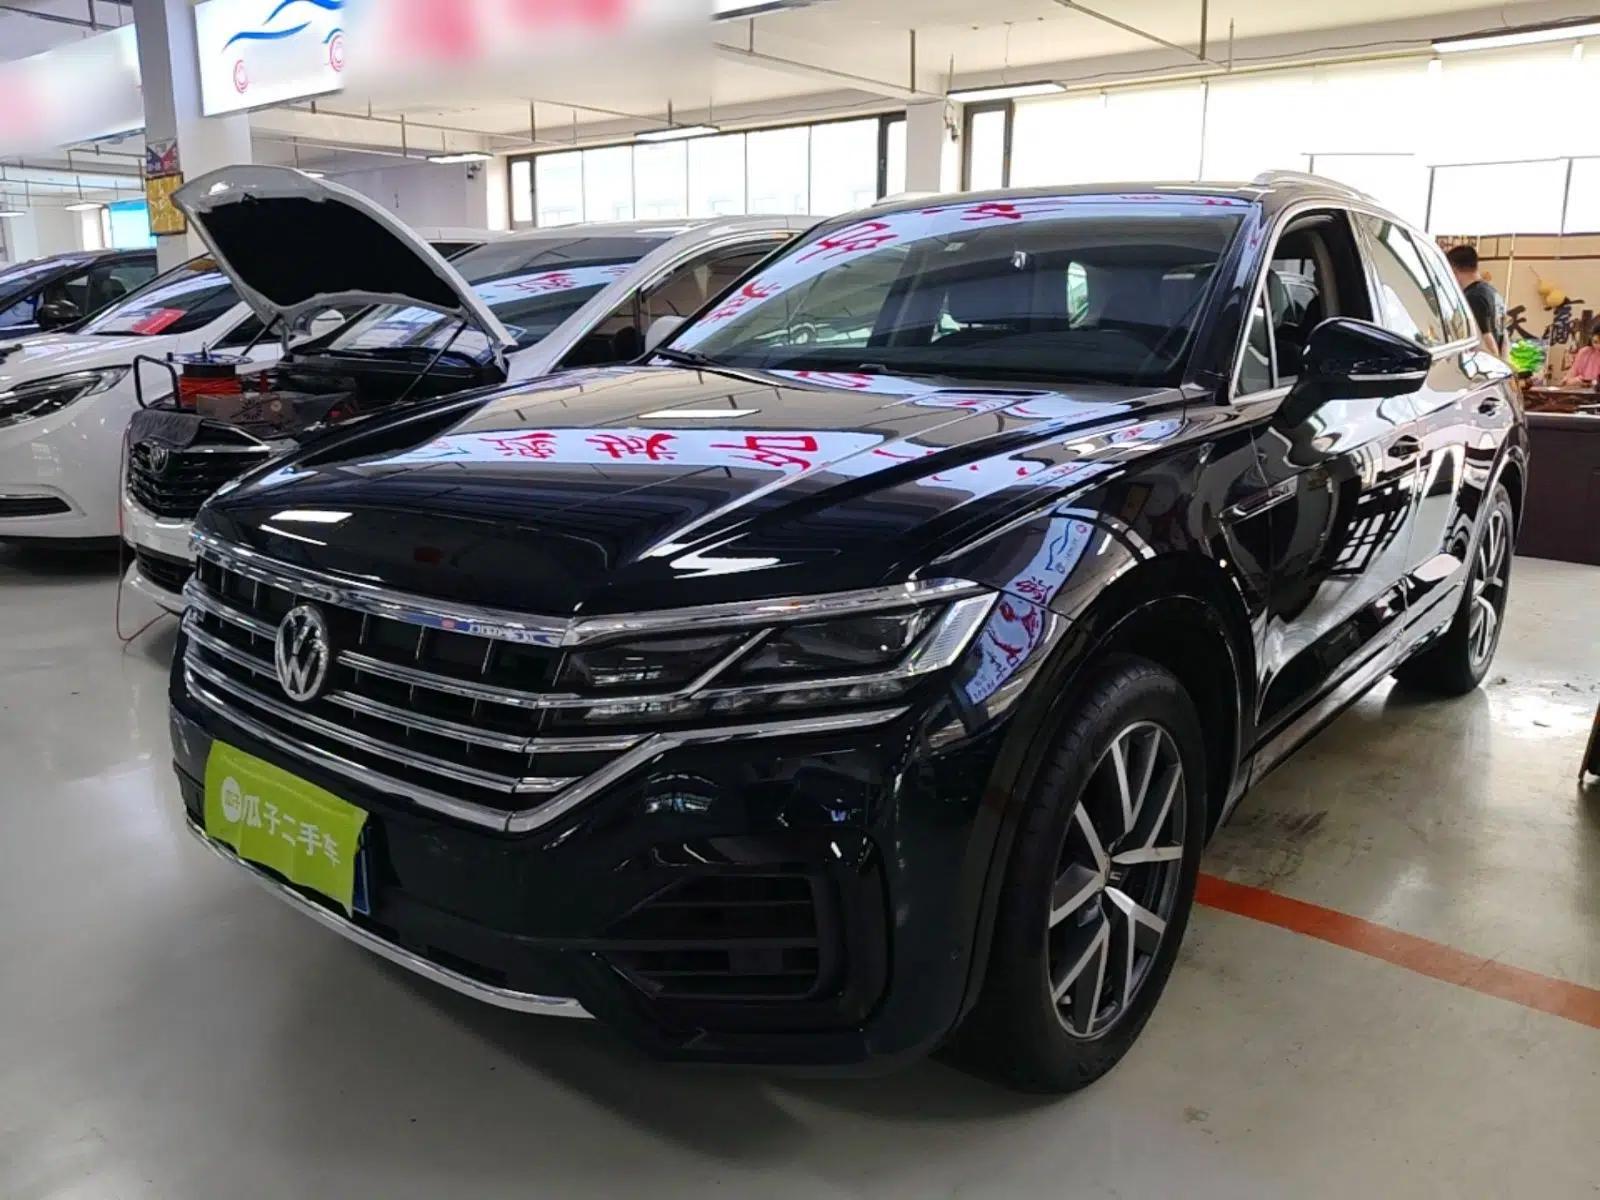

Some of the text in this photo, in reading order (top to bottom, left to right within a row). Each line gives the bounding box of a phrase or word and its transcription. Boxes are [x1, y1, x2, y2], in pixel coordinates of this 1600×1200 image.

[241, 795, 341, 868] 瓜子二手车
